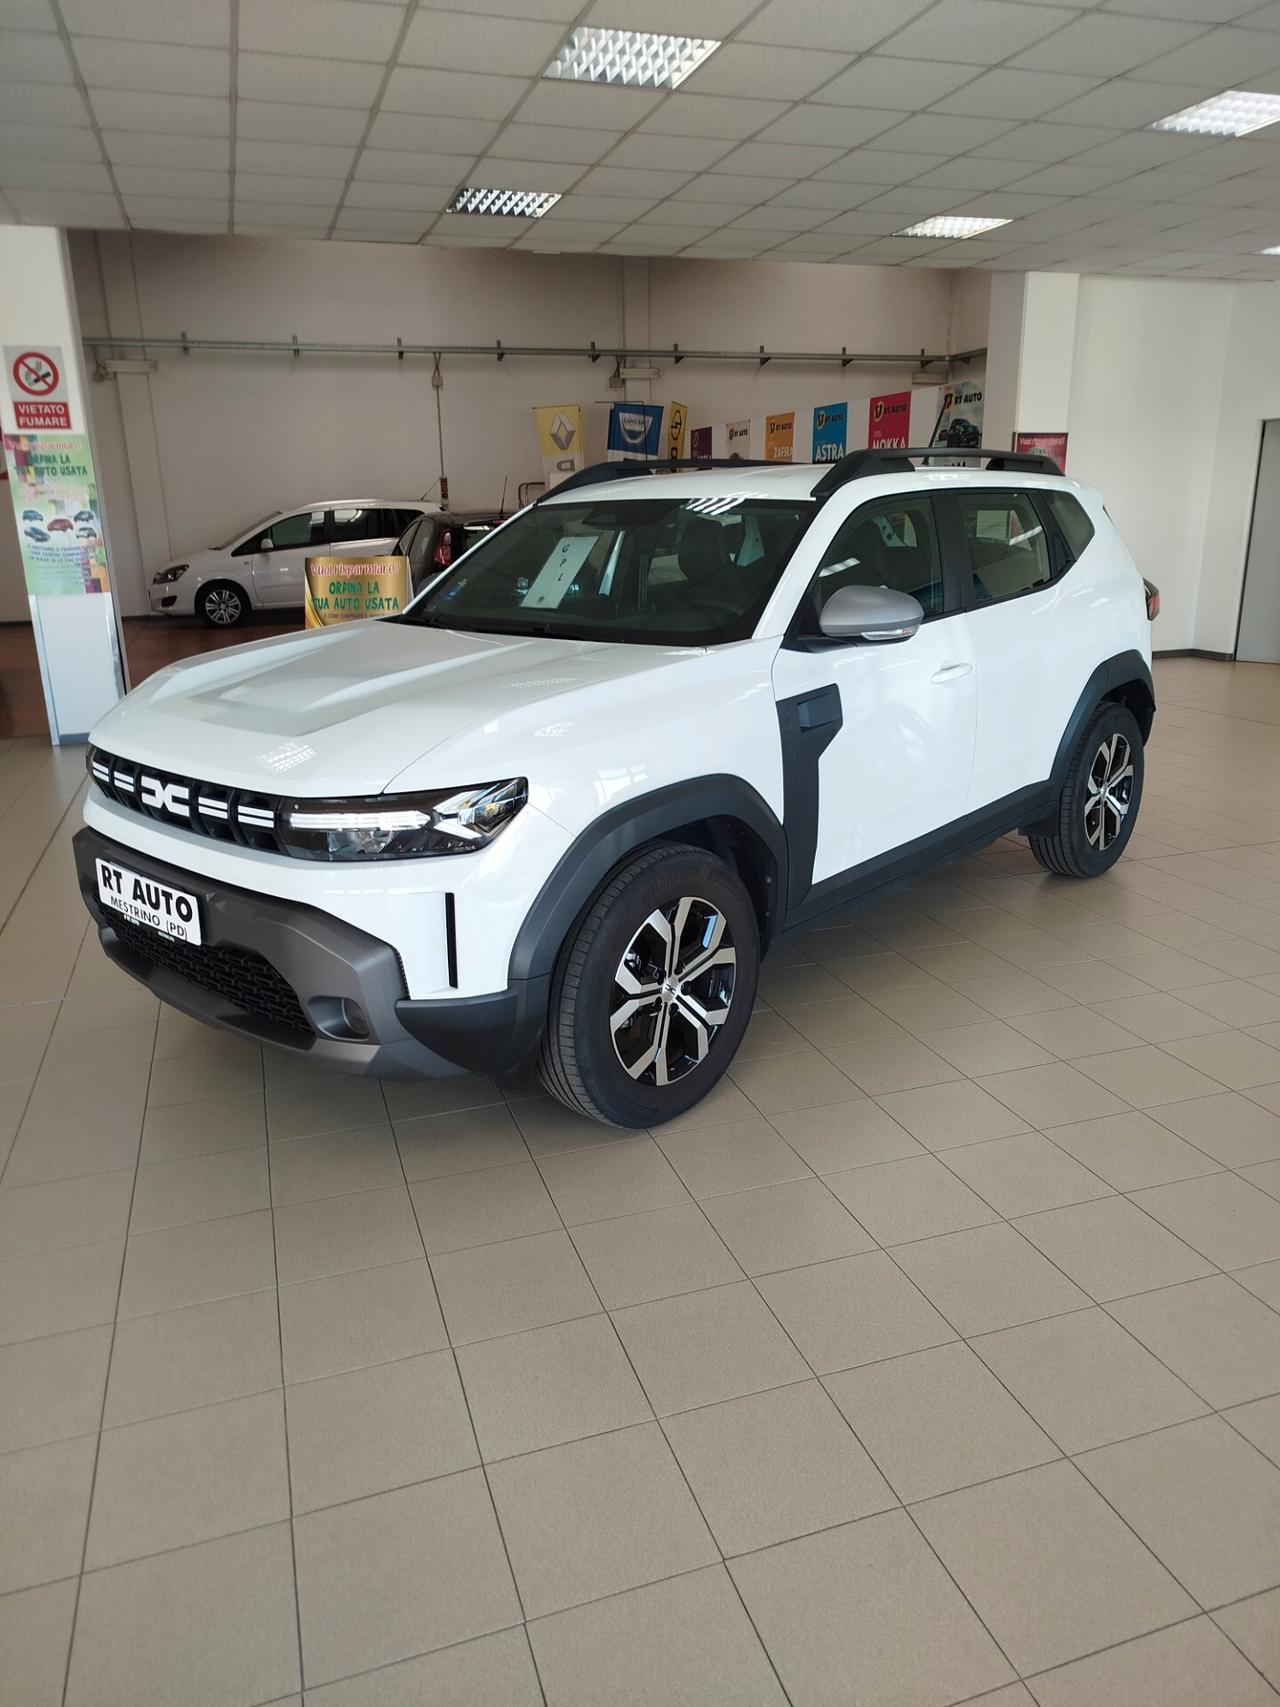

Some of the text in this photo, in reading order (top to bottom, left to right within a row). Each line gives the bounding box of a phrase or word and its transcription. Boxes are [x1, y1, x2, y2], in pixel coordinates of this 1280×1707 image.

[964, 392, 982, 403] AUTO
[18, 405, 65, 415] VIETATO
[20, 417, 68, 427] FUMARE
[815, 443, 845, 462] ASTRA
[60, 454, 71, 465] LA
[60, 465, 88, 476] USATA
[329, 581, 380, 595] ORPINA LA
[313, 596, 399, 610] TUA AUTO USATA
[101, 864, 193, 923] RT AUTO
[110, 896, 188, 941] MESTRINO (PD)
